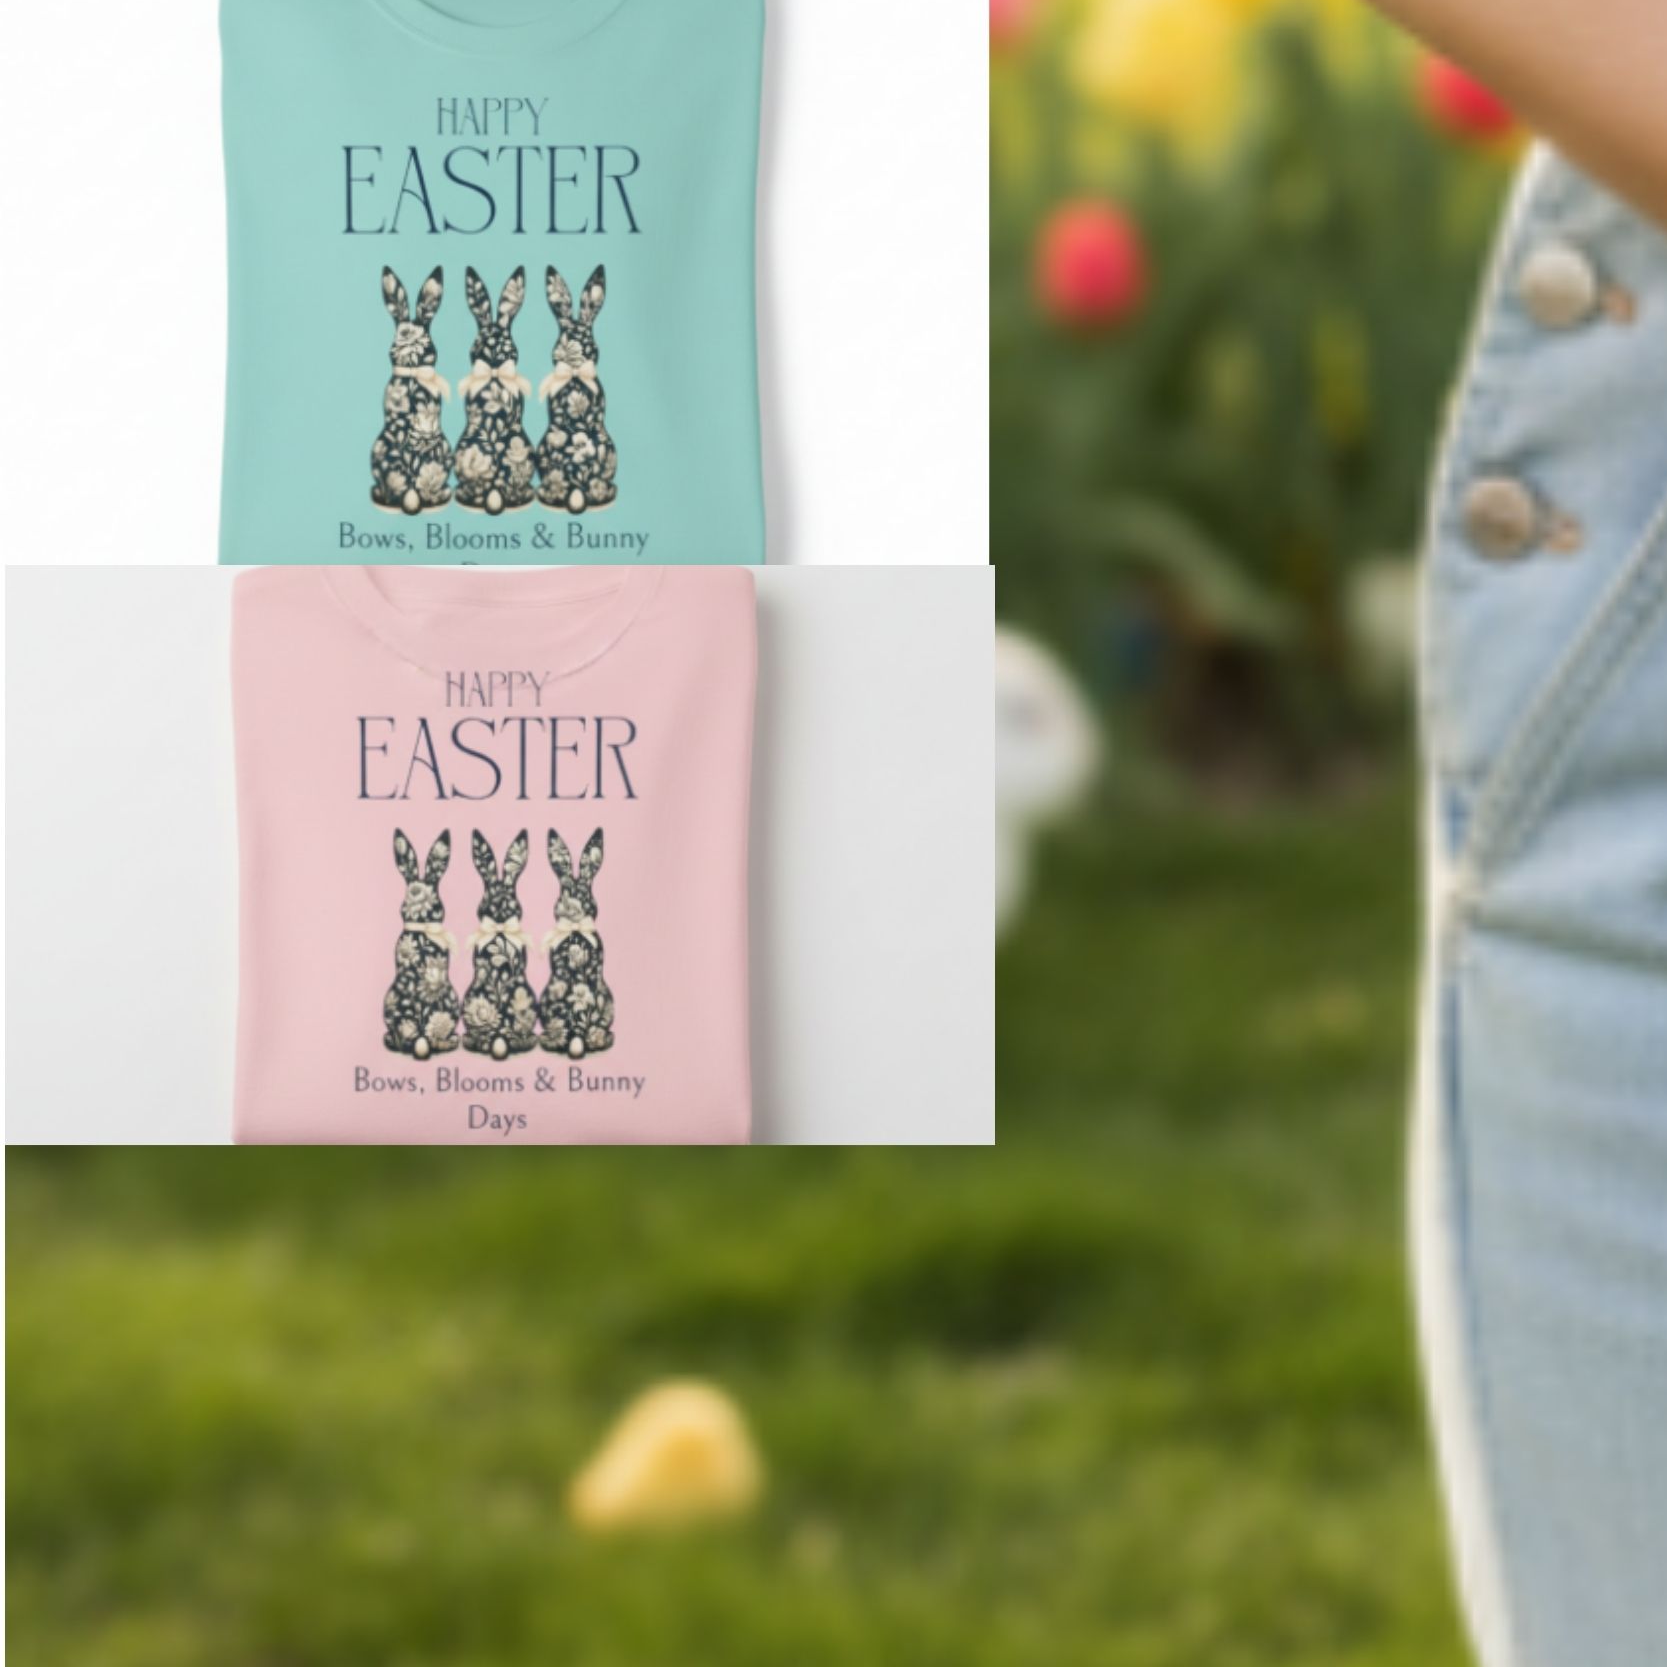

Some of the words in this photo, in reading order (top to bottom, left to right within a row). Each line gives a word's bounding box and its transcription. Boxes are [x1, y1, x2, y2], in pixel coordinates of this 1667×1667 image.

[436, 96, 548, 137] HAPPY
[342, 144, 642, 235] EASTER
[339, 521, 415, 553] Bows,
[426, 522, 522, 551] Blooms
[530, 521, 556, 550] &
[567, 521, 650, 556] Bunny
[445, 670, 549, 708] HAPPY
[357, 716, 638, 801] EASTER
[354, 1066, 426, 1096] Bows,
[435, 1066, 525, 1093] Blooms
[533, 1066, 556, 1093] &
[568, 1066, 646, 1099] Bunny
[467, 1104, 528, 1137] Days
